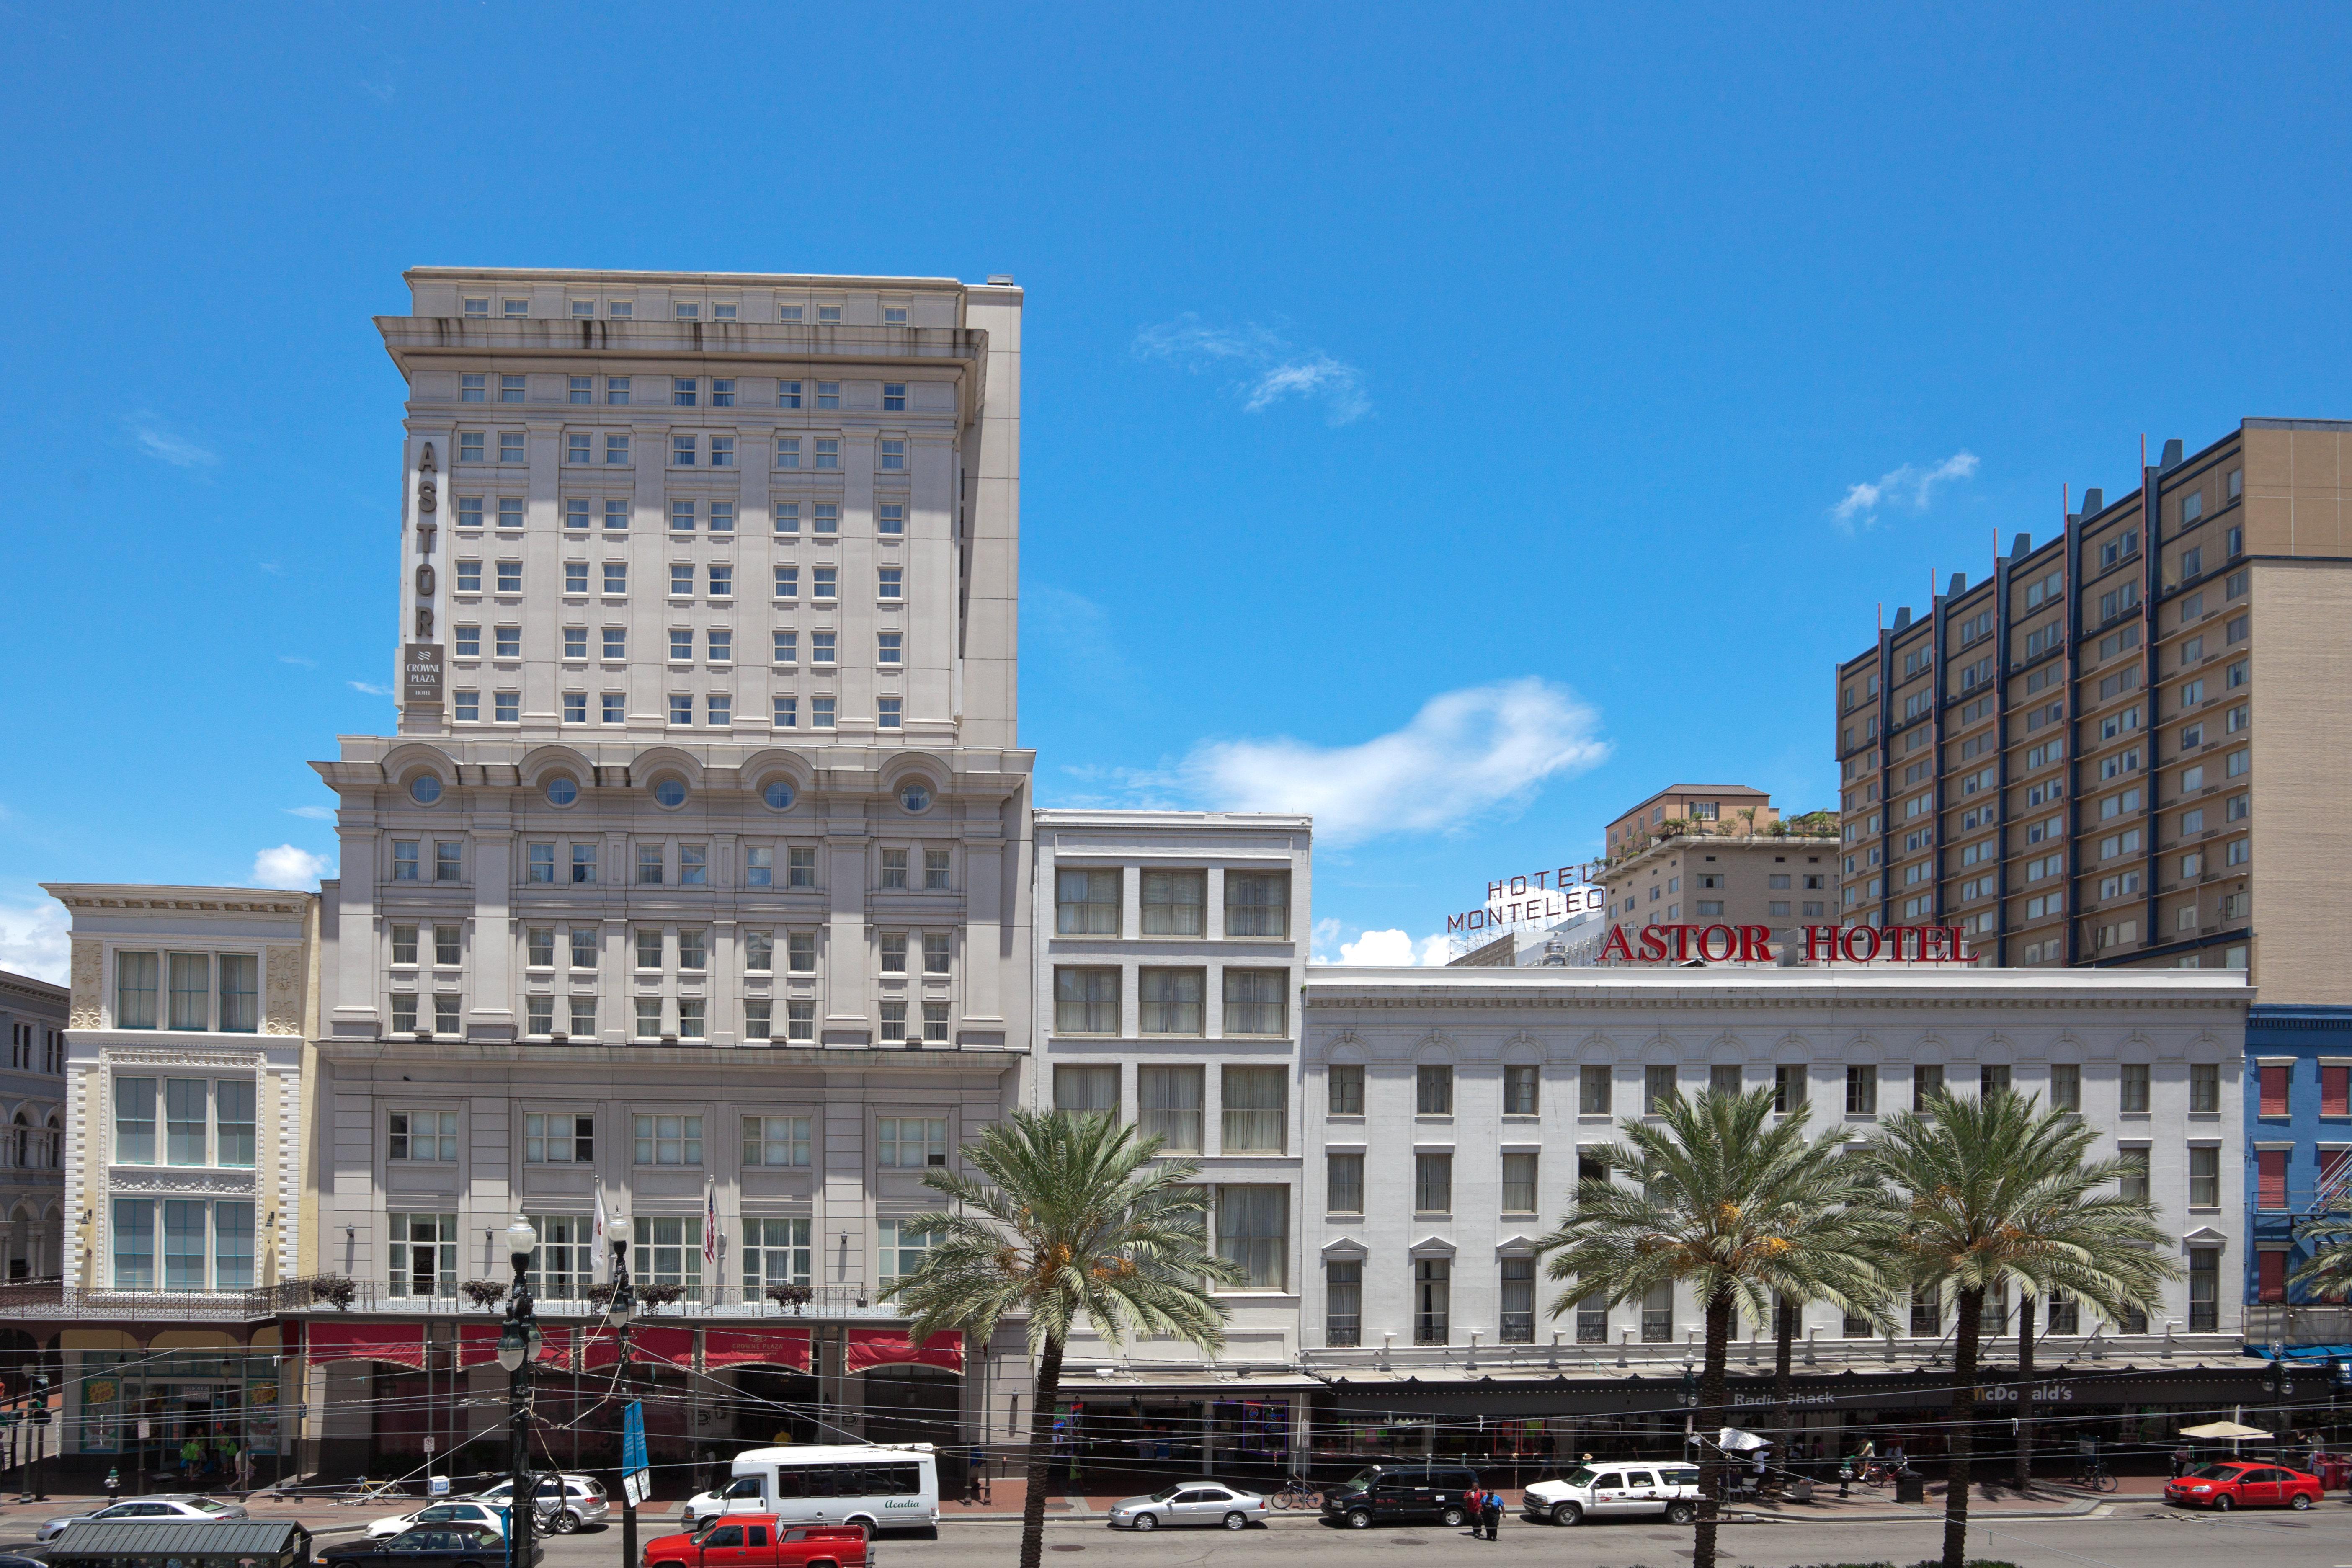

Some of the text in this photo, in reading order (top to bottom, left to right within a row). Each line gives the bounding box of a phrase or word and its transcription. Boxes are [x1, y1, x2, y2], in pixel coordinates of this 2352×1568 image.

[415, 441, 437, 636] ASTOR
[406, 663, 441, 673] CROWNE
[411, 674, 436, 683] PLAZA
[1488, 863, 1591, 901] HOTEL
[1596, 923, 1981, 963] ASTOR HOTEL
[94, 1389, 111, 1401] $20
[1787, 1391, 1835, 1405] Shack
[1973, 1385, 2072, 1401] McDoald's
[885, 1499, 921, 1508] Acadia
